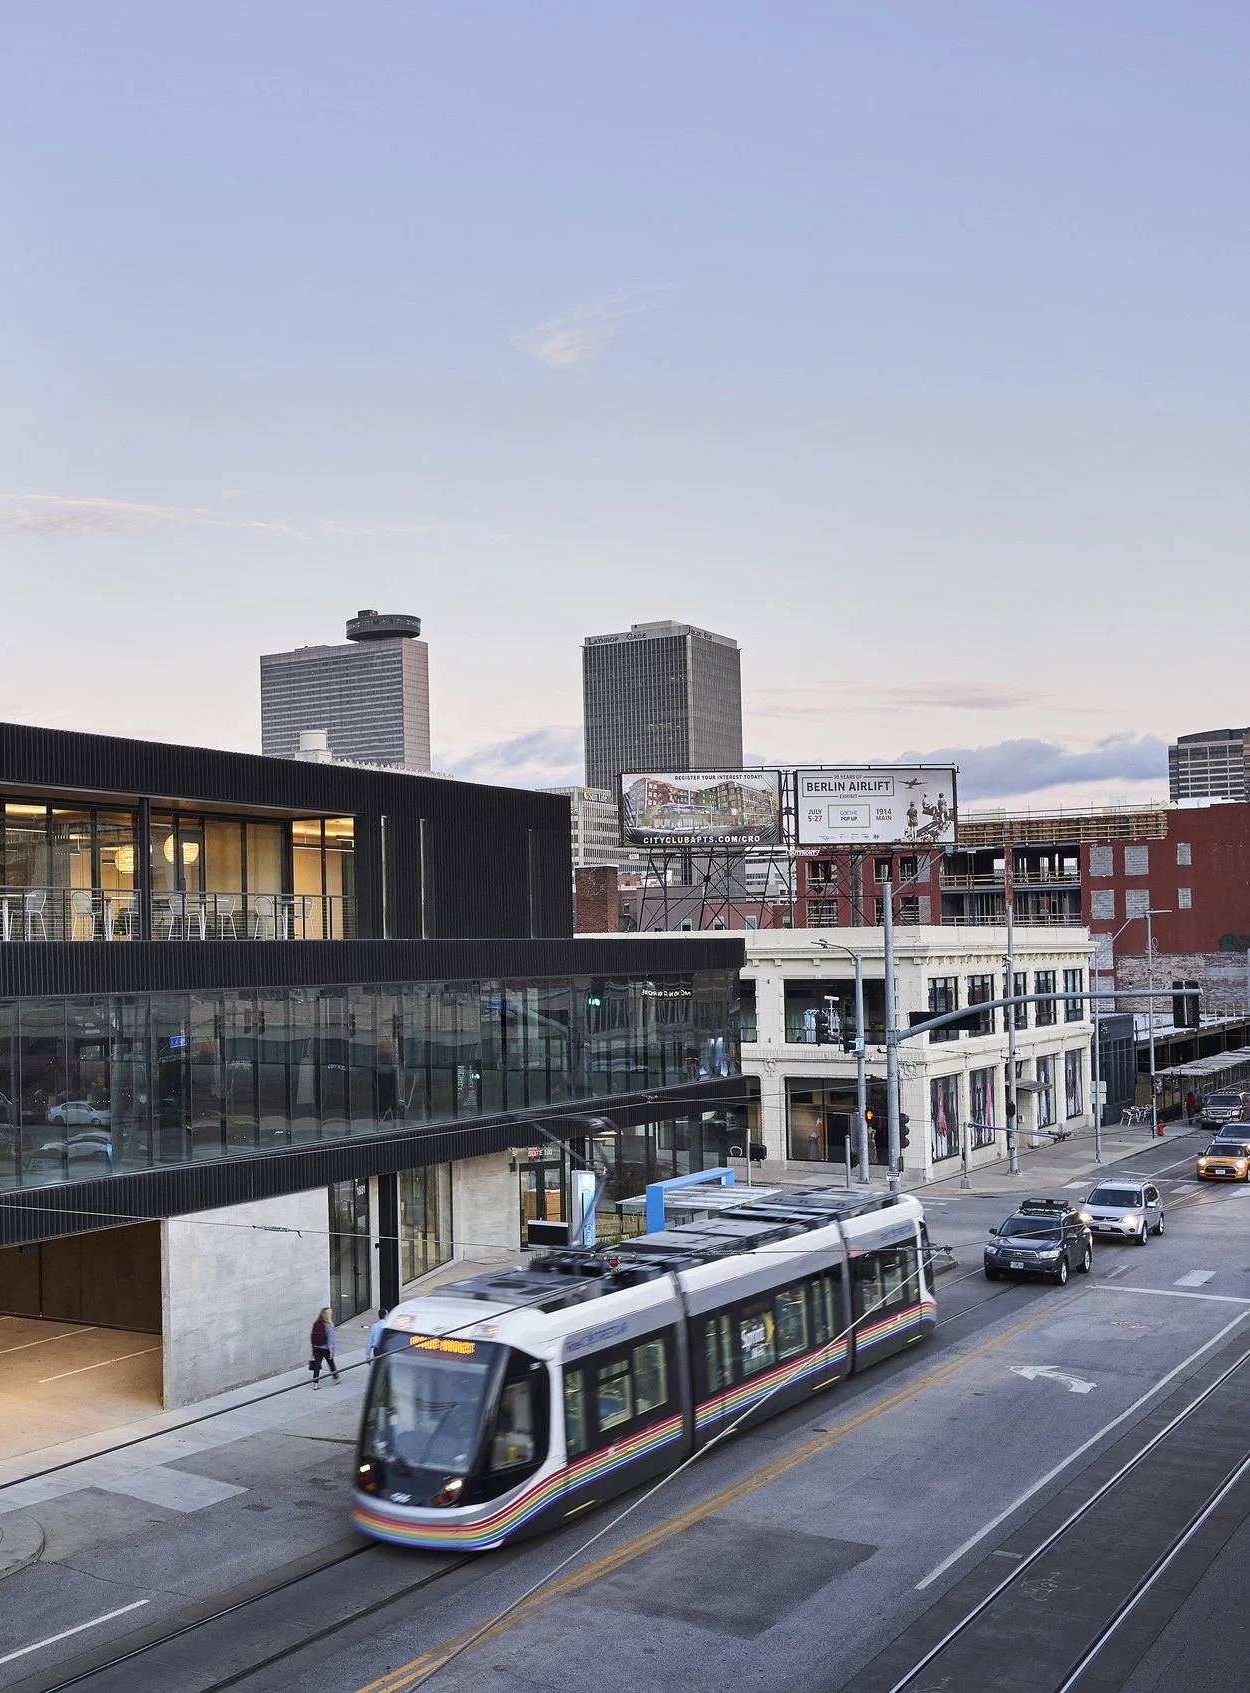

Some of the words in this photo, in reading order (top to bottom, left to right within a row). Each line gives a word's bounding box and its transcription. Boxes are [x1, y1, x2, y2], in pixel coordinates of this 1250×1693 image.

[588, 636, 619, 646] LATHROP
[806, 781, 846, 792] BERLIN
[848, 781, 890, 791] AIRLIFT
[643, 835, 761, 844] CITYCLUBAPTS.COM/CRO
